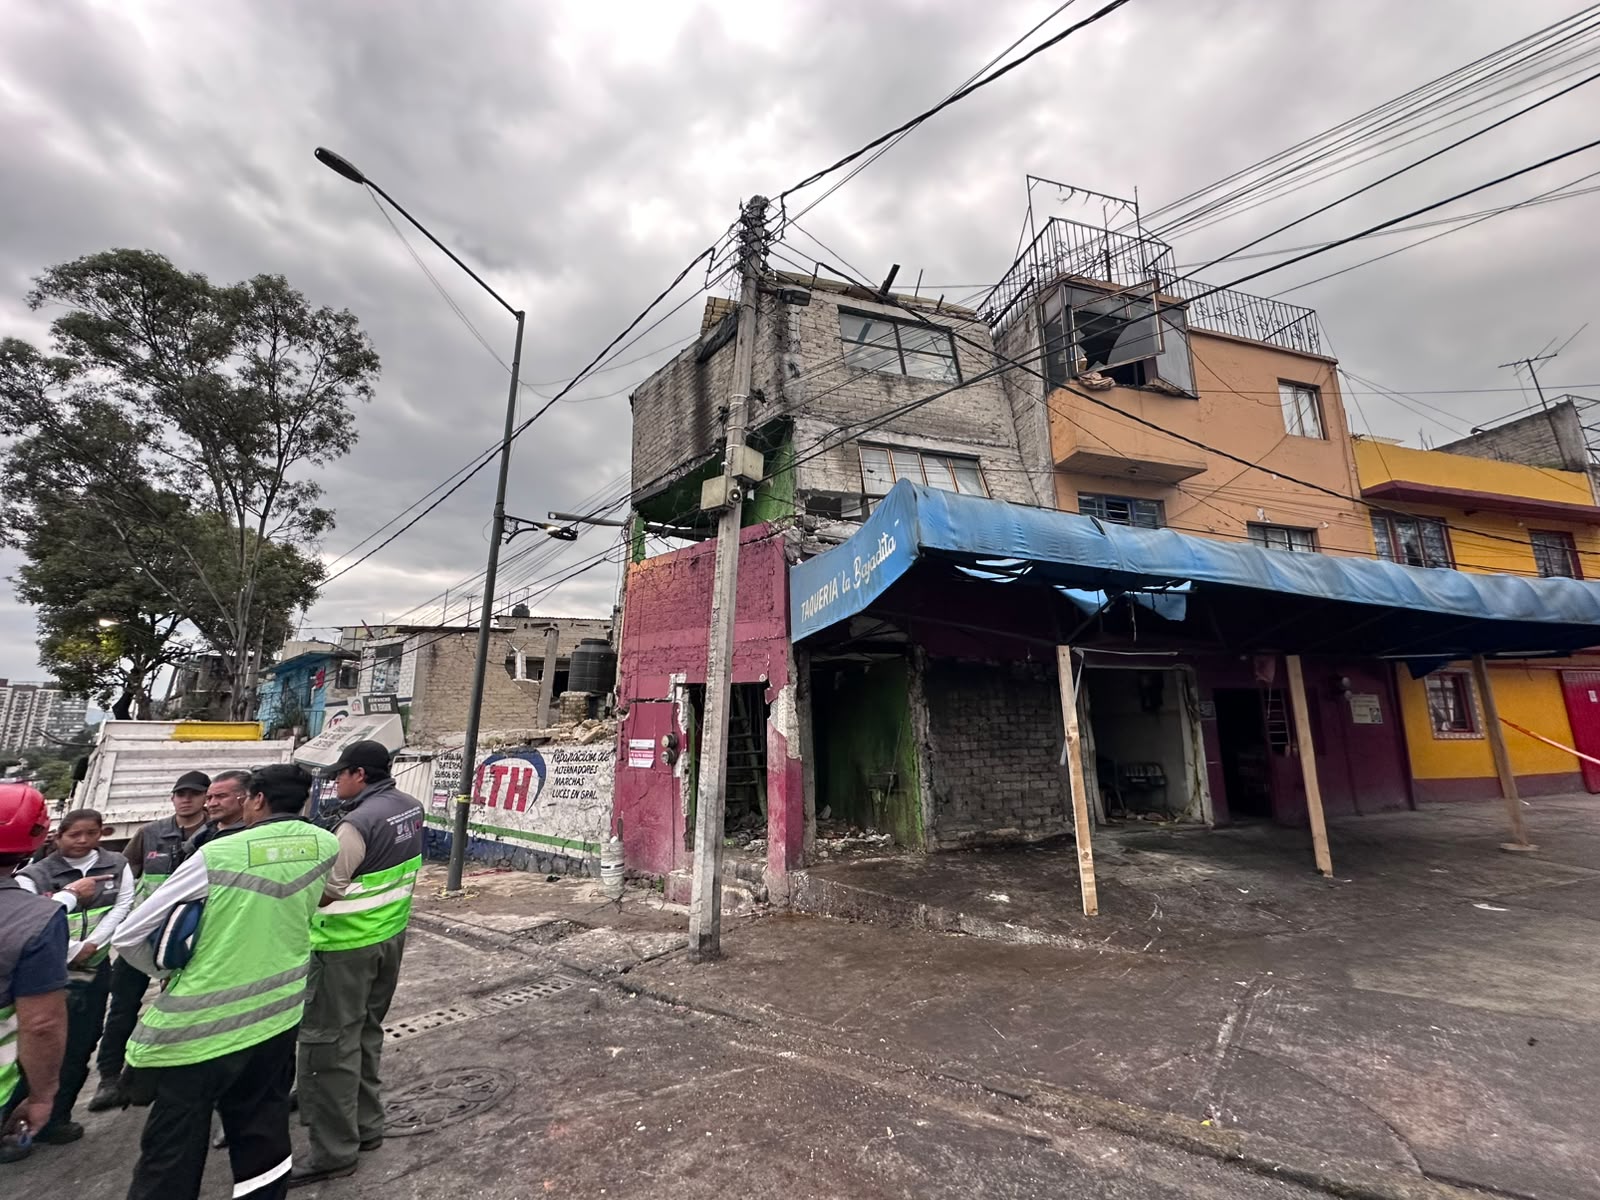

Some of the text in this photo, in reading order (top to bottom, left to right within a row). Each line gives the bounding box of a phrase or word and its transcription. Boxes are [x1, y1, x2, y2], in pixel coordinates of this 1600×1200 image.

[801, 577, 838, 622] TAQUERIA
[554, 765, 599, 774] ALTERNADORES
[554, 777, 586, 786] MARCHAS
[472, 764, 533, 813] LTH
[551, 789, 570, 799] LUCES
[570, 790, 581, 799] EN
